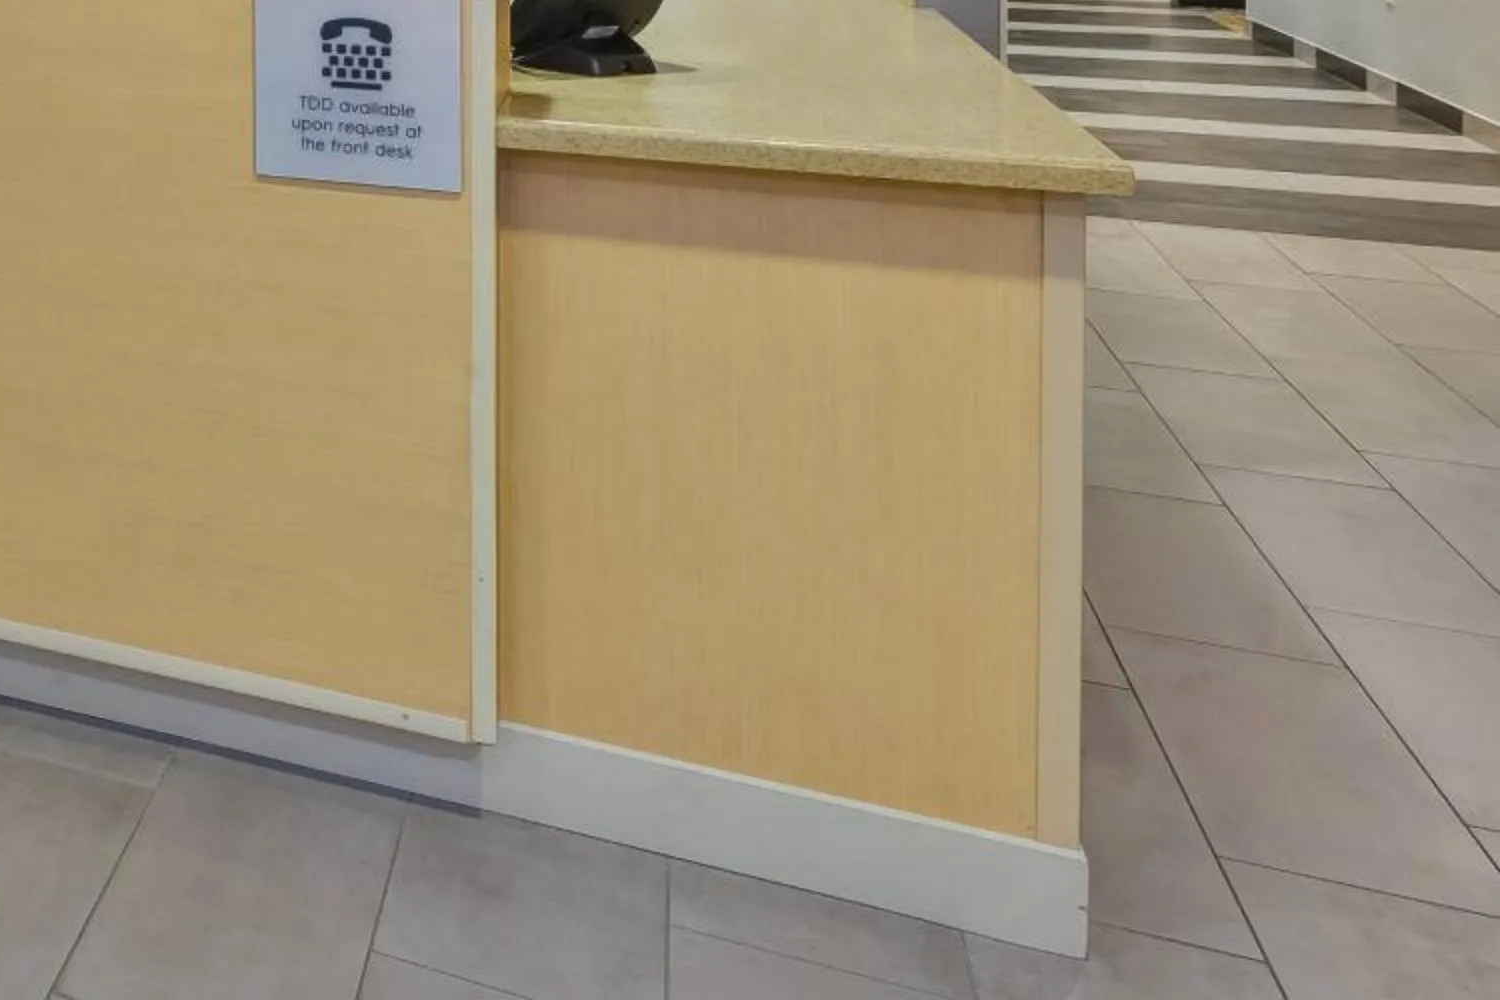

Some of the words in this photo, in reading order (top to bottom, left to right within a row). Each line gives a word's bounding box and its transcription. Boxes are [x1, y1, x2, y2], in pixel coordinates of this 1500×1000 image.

[299, 95, 335, 112] TDD
[339, 100, 416, 118] available
[292, 117, 332, 135] upon
[338, 122, 399, 141] request
[405, 124, 423, 139] at
[301, 136, 325, 152] the
[331, 140, 369, 155] front
[375, 143, 414, 159] desk
